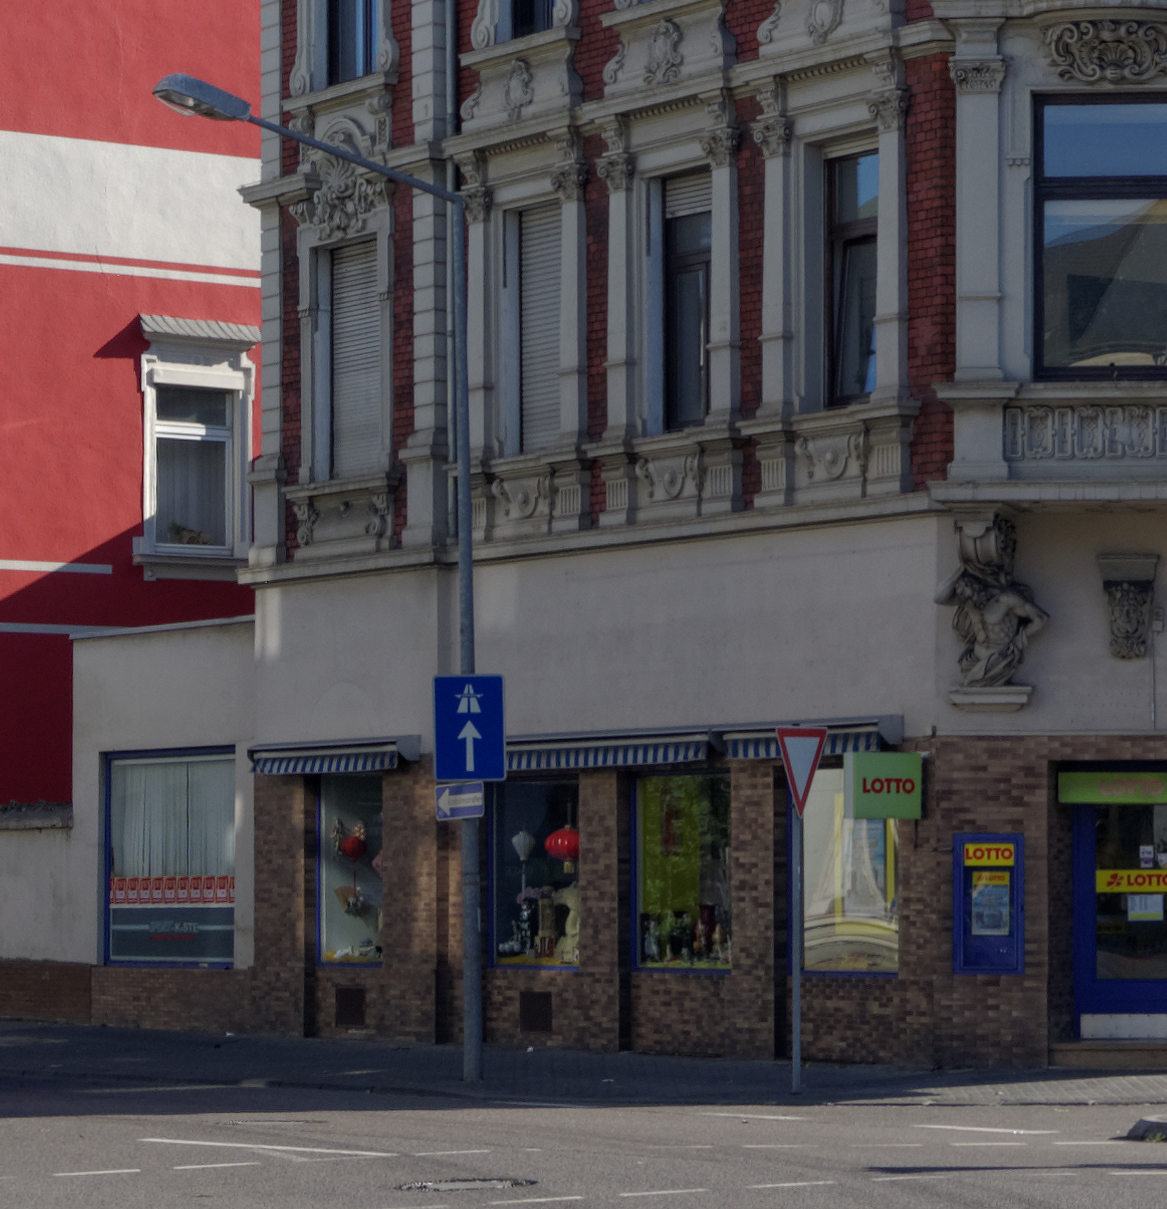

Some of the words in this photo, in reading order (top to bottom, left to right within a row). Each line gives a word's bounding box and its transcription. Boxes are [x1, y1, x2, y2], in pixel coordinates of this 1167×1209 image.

[862, 777, 916, 794] LOTTO
[1101, 778, 1165, 797] LOTTO
[965, 847, 1013, 860] LOTTO
